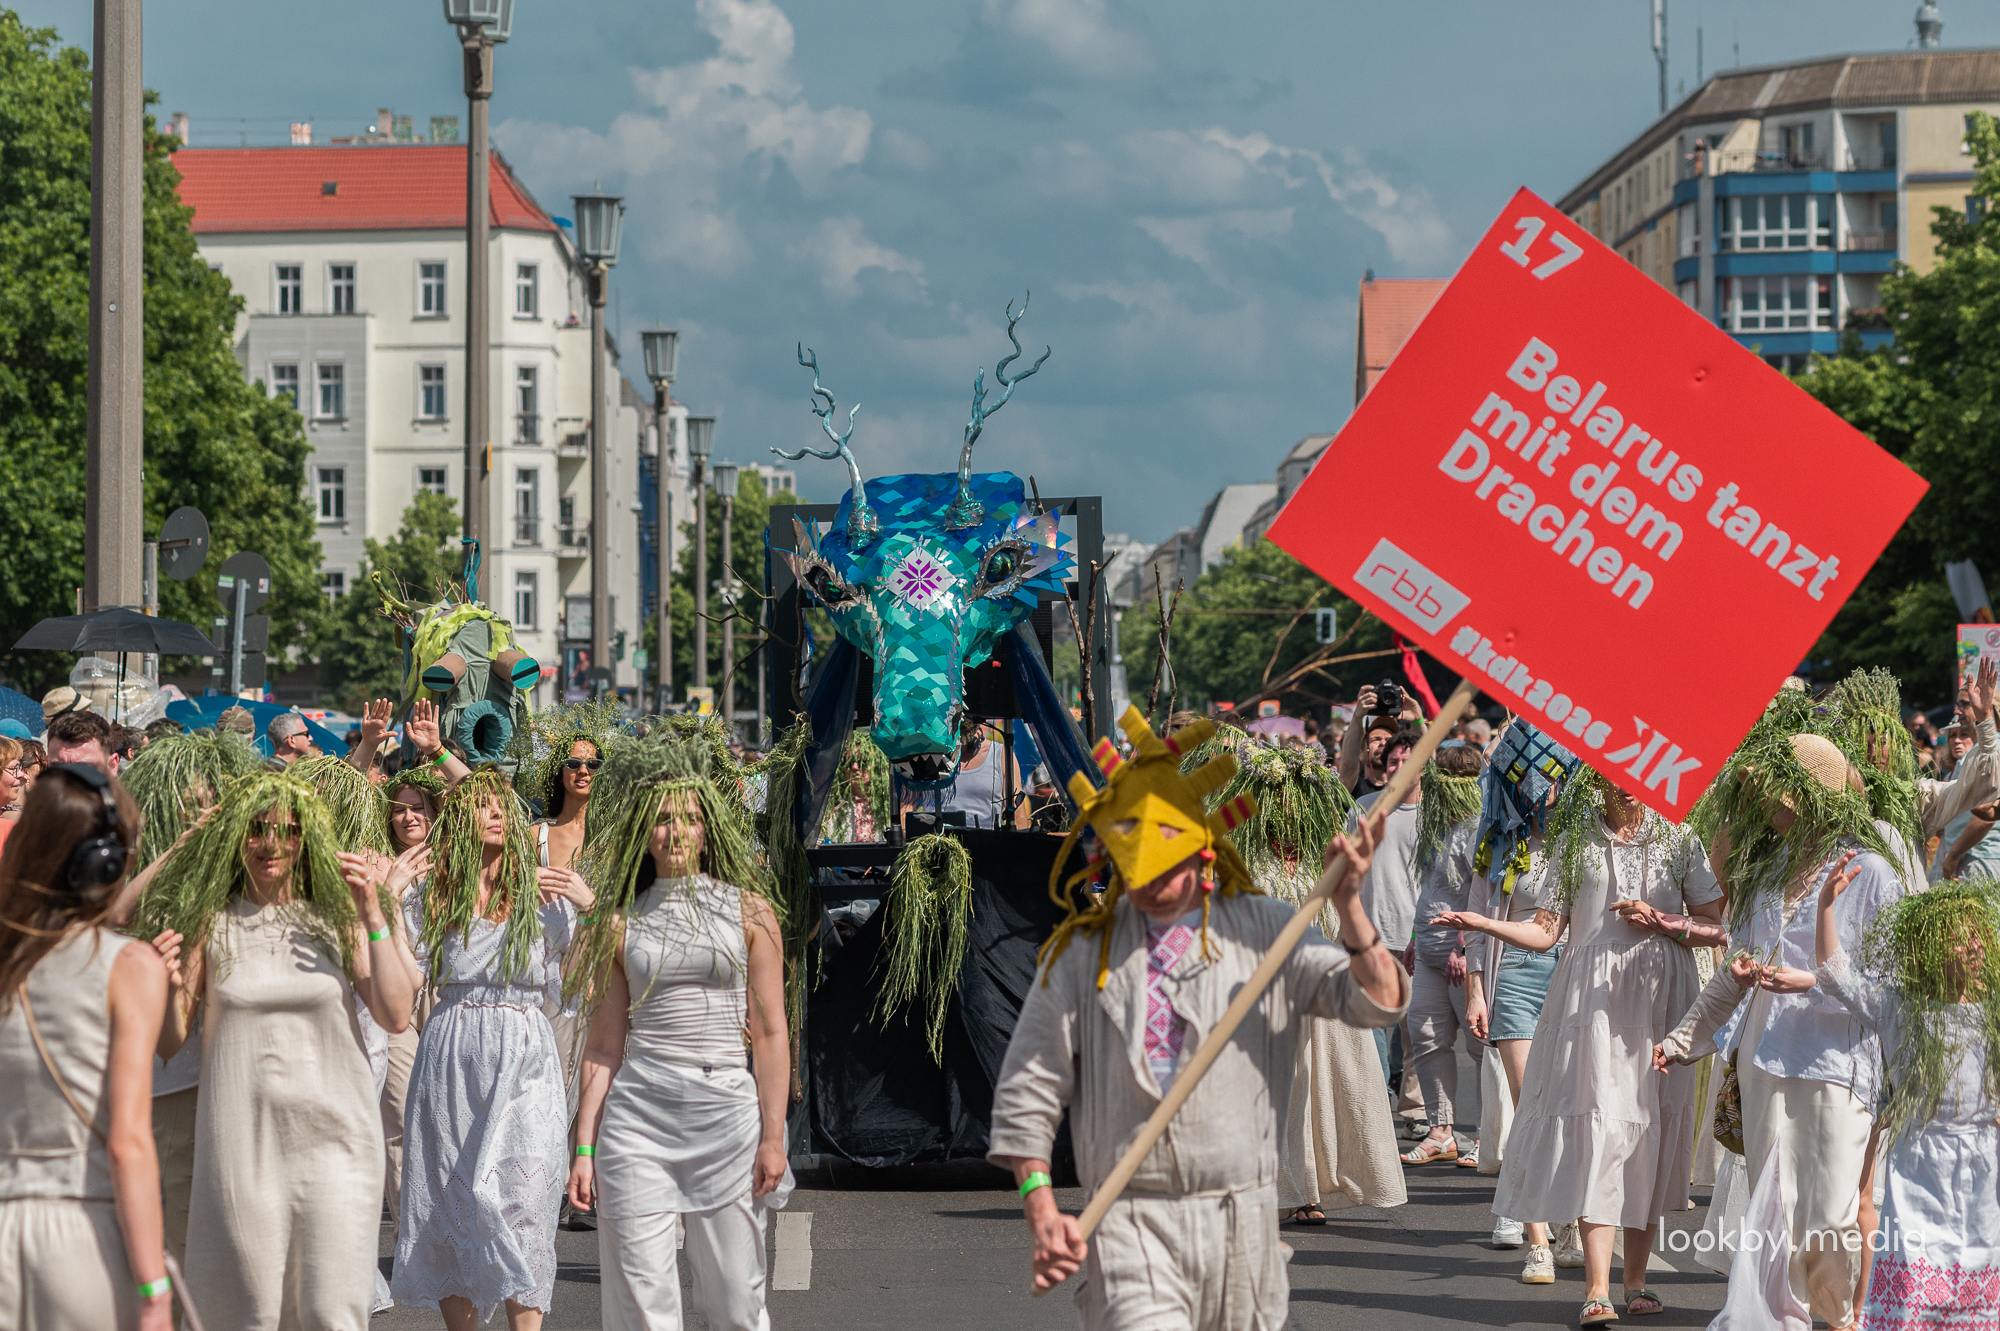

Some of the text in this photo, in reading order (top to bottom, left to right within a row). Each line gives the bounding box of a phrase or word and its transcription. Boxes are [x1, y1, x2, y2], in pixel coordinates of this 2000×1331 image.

[1499, 216, 1584, 281] 17
[1438, 428, 1654, 610] Drachen
[1470, 391, 1684, 562] mit dem
[1505, 336, 1840, 602] Belarus tanzt
[1369, 563, 1443, 619] rbb
[1449, 625, 1613, 750] #kdk2026
